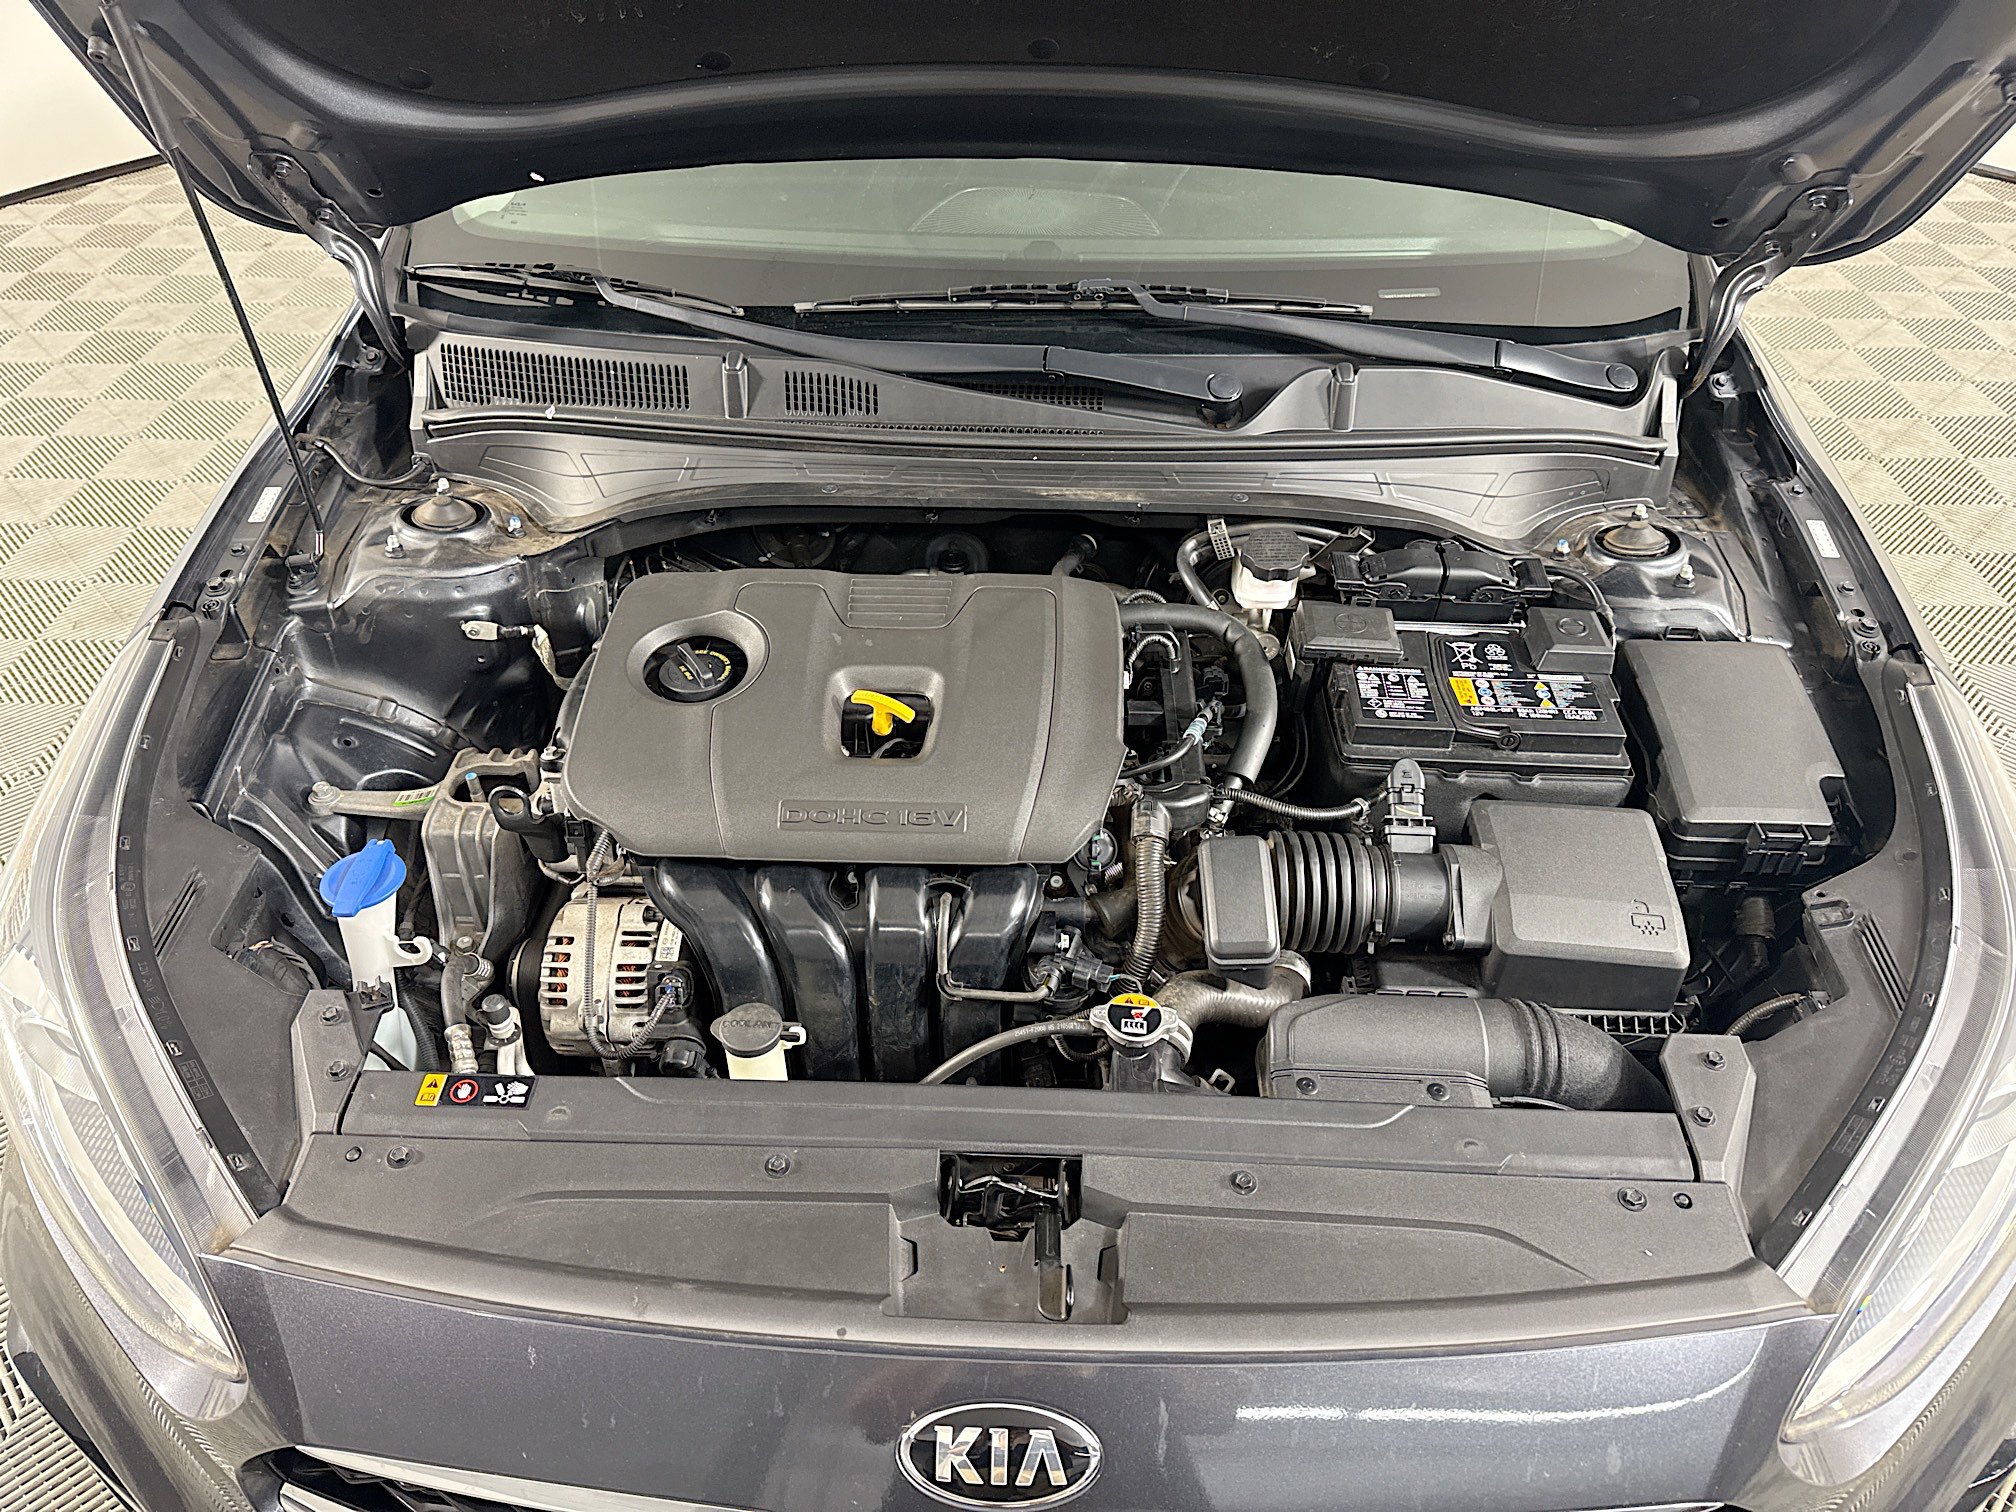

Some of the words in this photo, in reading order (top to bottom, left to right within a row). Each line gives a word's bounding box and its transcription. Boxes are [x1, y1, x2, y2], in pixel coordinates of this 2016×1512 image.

[1461, 662, 1477, 670] Pb
[781, 807, 890, 825] DOHC
[899, 808, 964, 826] 16V
[722, 1019, 780, 1029] COOLANT
[934, 1425, 1068, 1487] KIA
